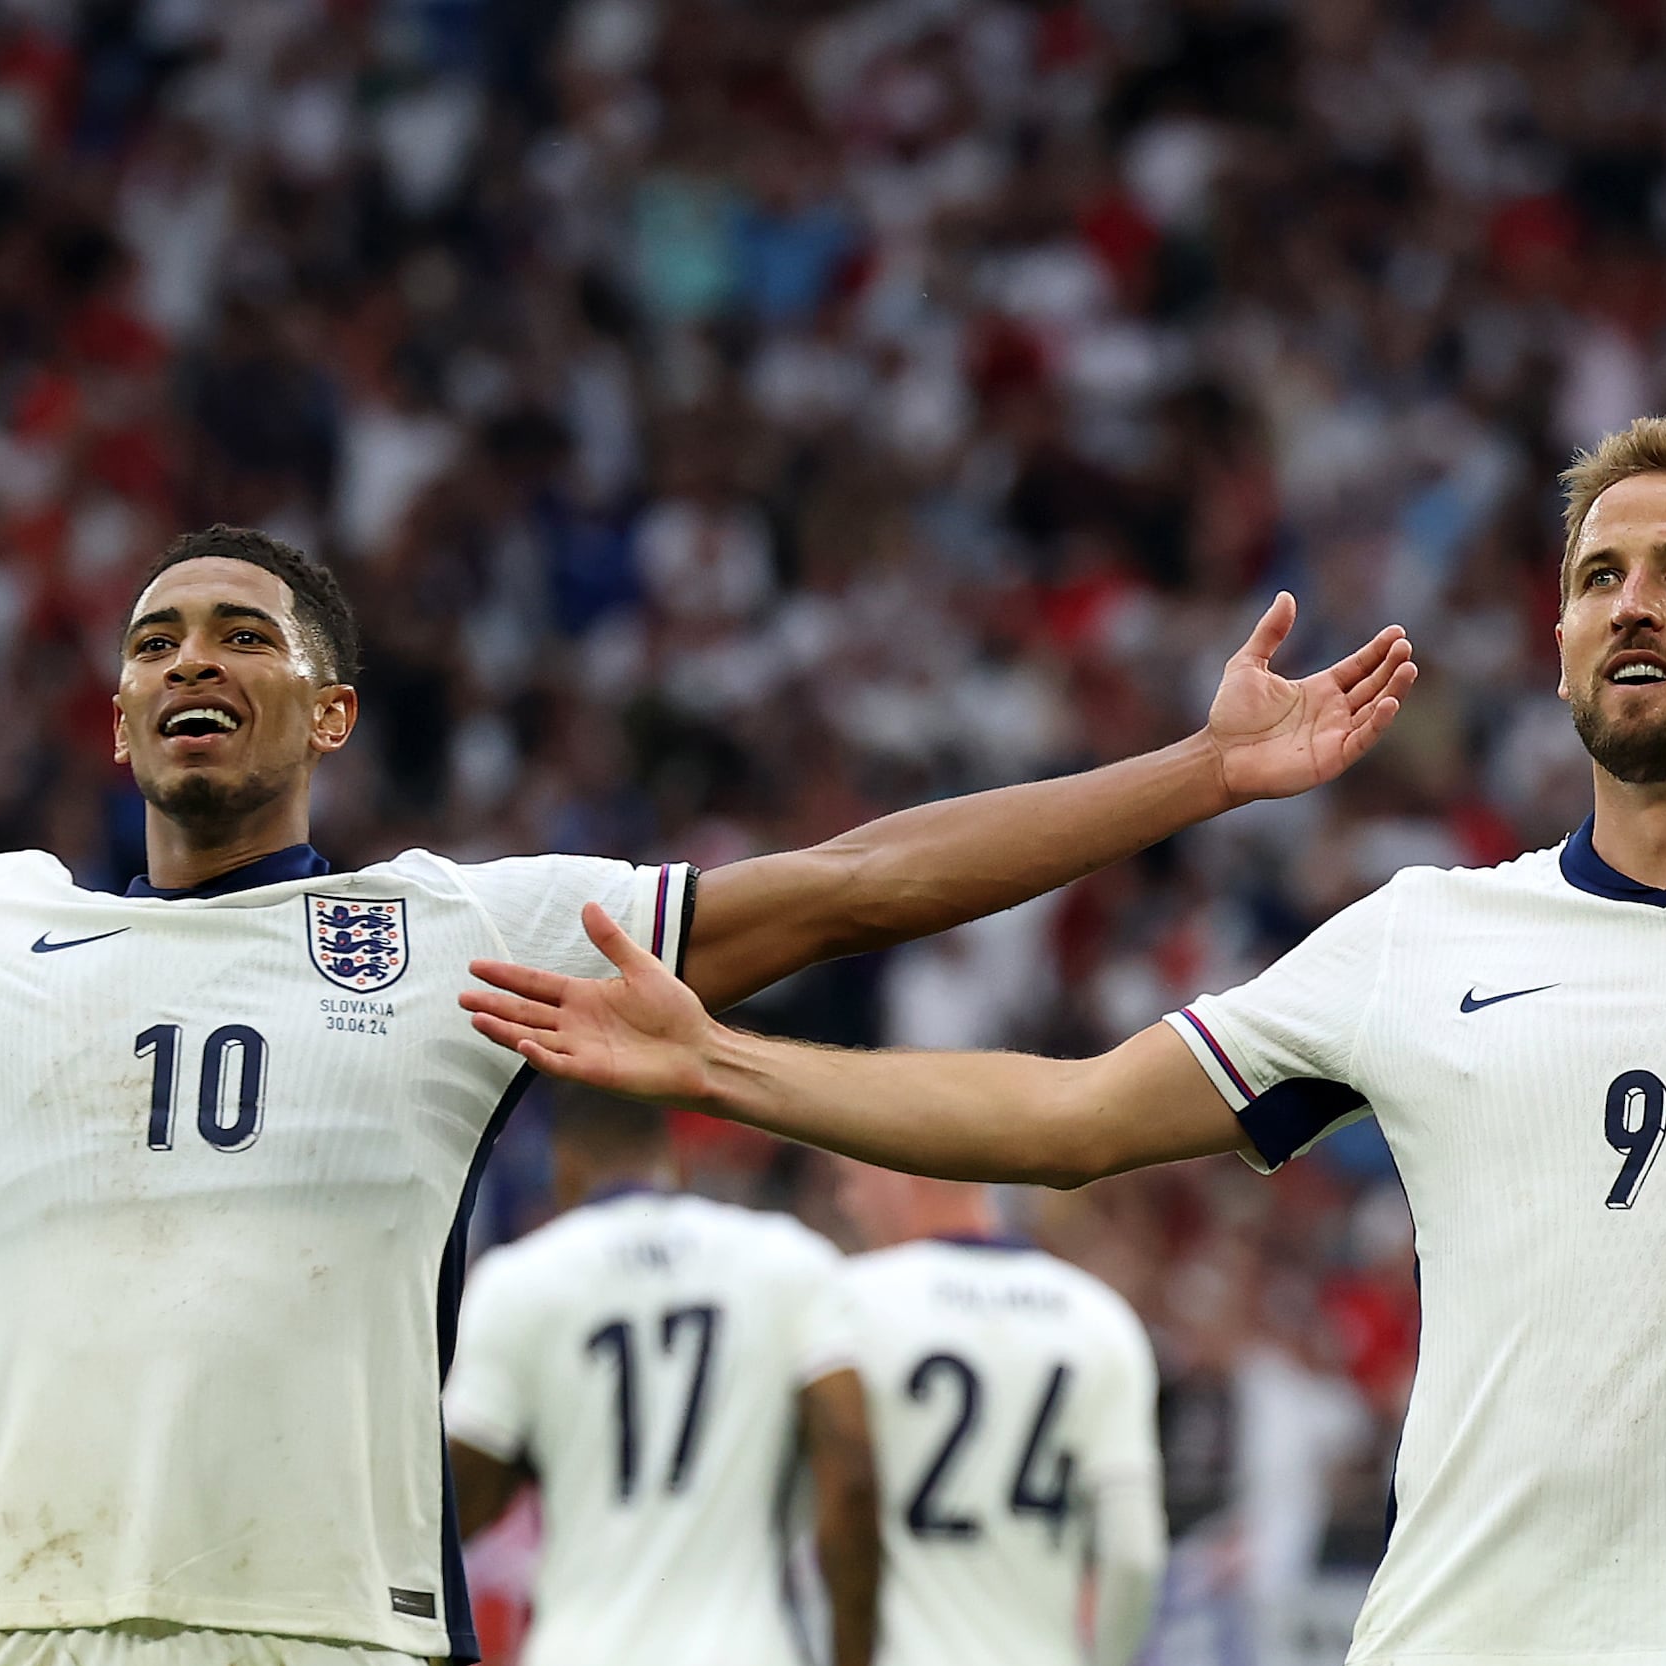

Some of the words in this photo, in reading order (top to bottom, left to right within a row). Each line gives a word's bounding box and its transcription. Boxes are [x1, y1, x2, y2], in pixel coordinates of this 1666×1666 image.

[320, 999, 395, 1017] SLOVAKIA
[326, 1016, 387, 1036] 30.06.24
[134, 1024, 269, 1154] 10
[583, 1300, 722, 1503] 17
[905, 1347, 1077, 1546] 24
